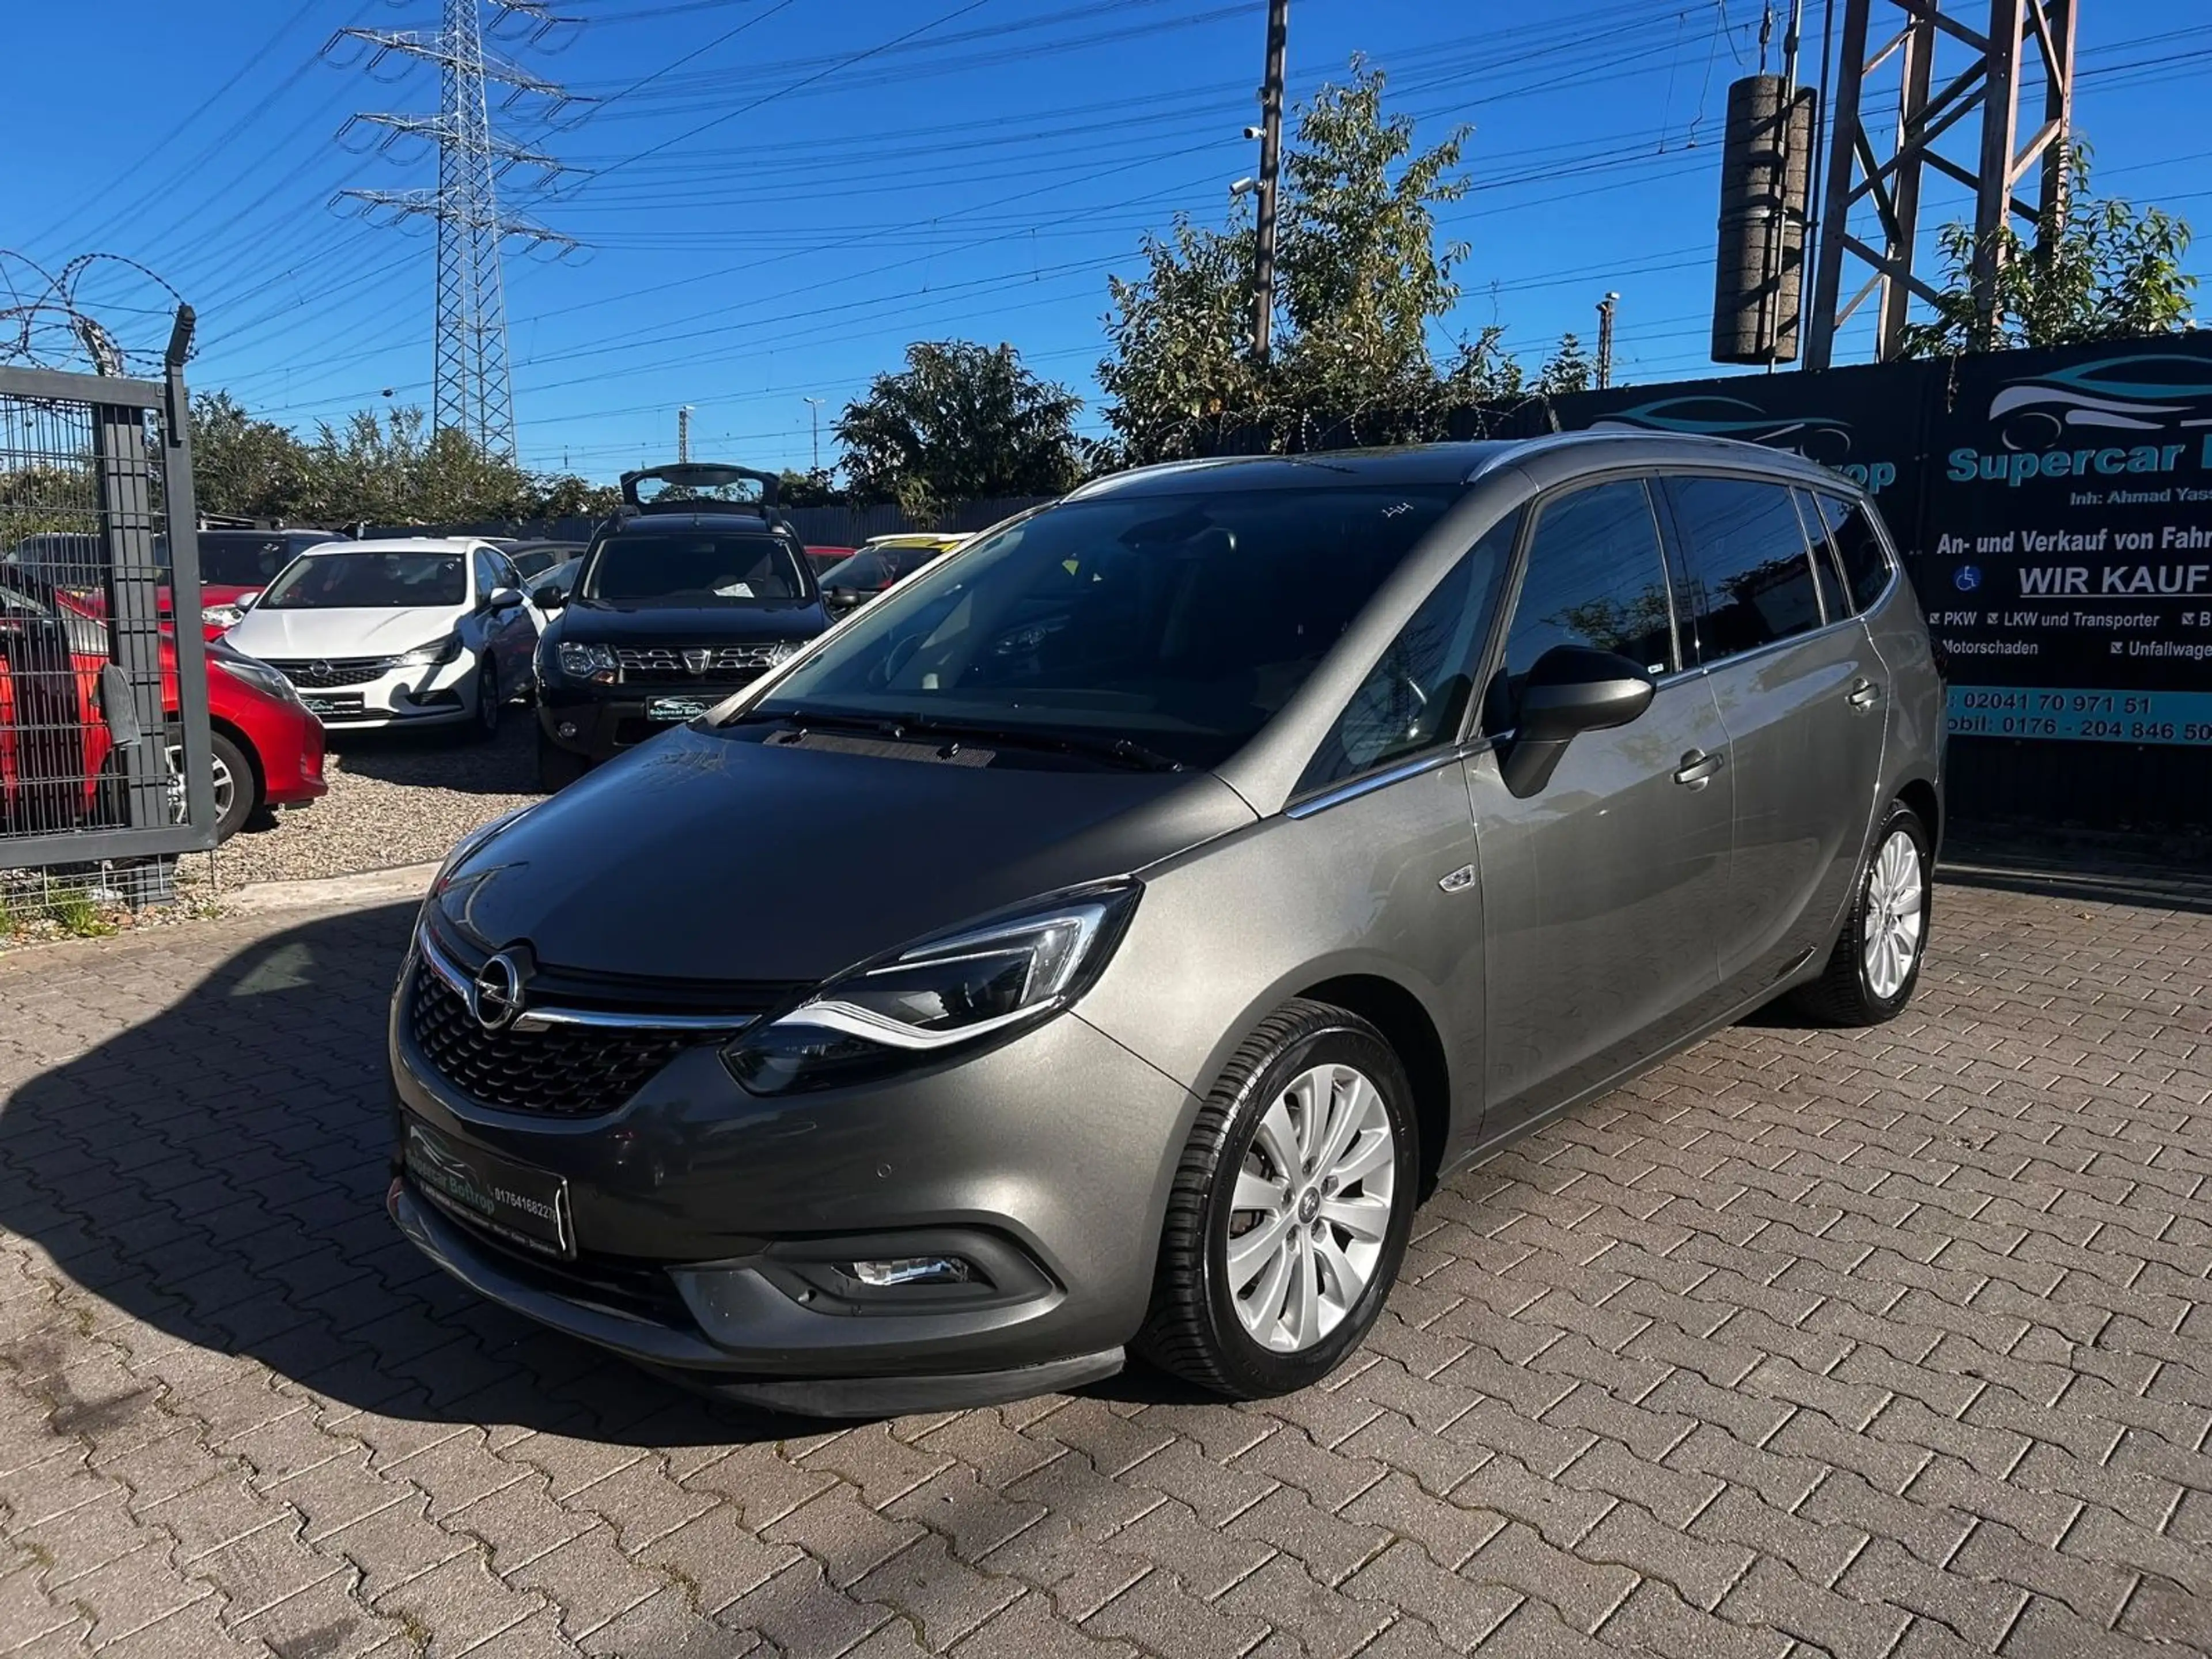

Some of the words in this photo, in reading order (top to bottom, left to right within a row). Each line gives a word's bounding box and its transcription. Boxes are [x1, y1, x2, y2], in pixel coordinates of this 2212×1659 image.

[1947, 445, 2186, 487] Supercar
[2070, 491, 2103, 506] Inh:
[2107, 488, 2170, 505] Ahmad
[1937, 533, 1970, 554] An-
[1976, 531, 2015, 552] und
[2021, 528, 2108, 552] Verkauf
[2115, 533, 2154, 550] von
[2019, 567, 2089, 594] WIR
[2101, 566, 2210, 593] KAUF
[1944, 612, 1978, 626] PKW
[2004, 612, 2039, 626] LKW
[2041, 612, 2069, 626] und
[2074, 612, 2161, 630] Transporter
[2128, 641, 2212, 660] Unfallwage
[1963, 692, 2029, 710] 02041
[2039, 695, 2065, 711] 70
[2073, 695, 2114, 712] 971
[2124, 697, 2152, 714] 51
[2002, 718, 2056, 734] 0176
[2081, 720, 2123, 737] 204
[2132, 721, 2175, 739] 846
[449, 1173, 495, 1215] Bottrop
